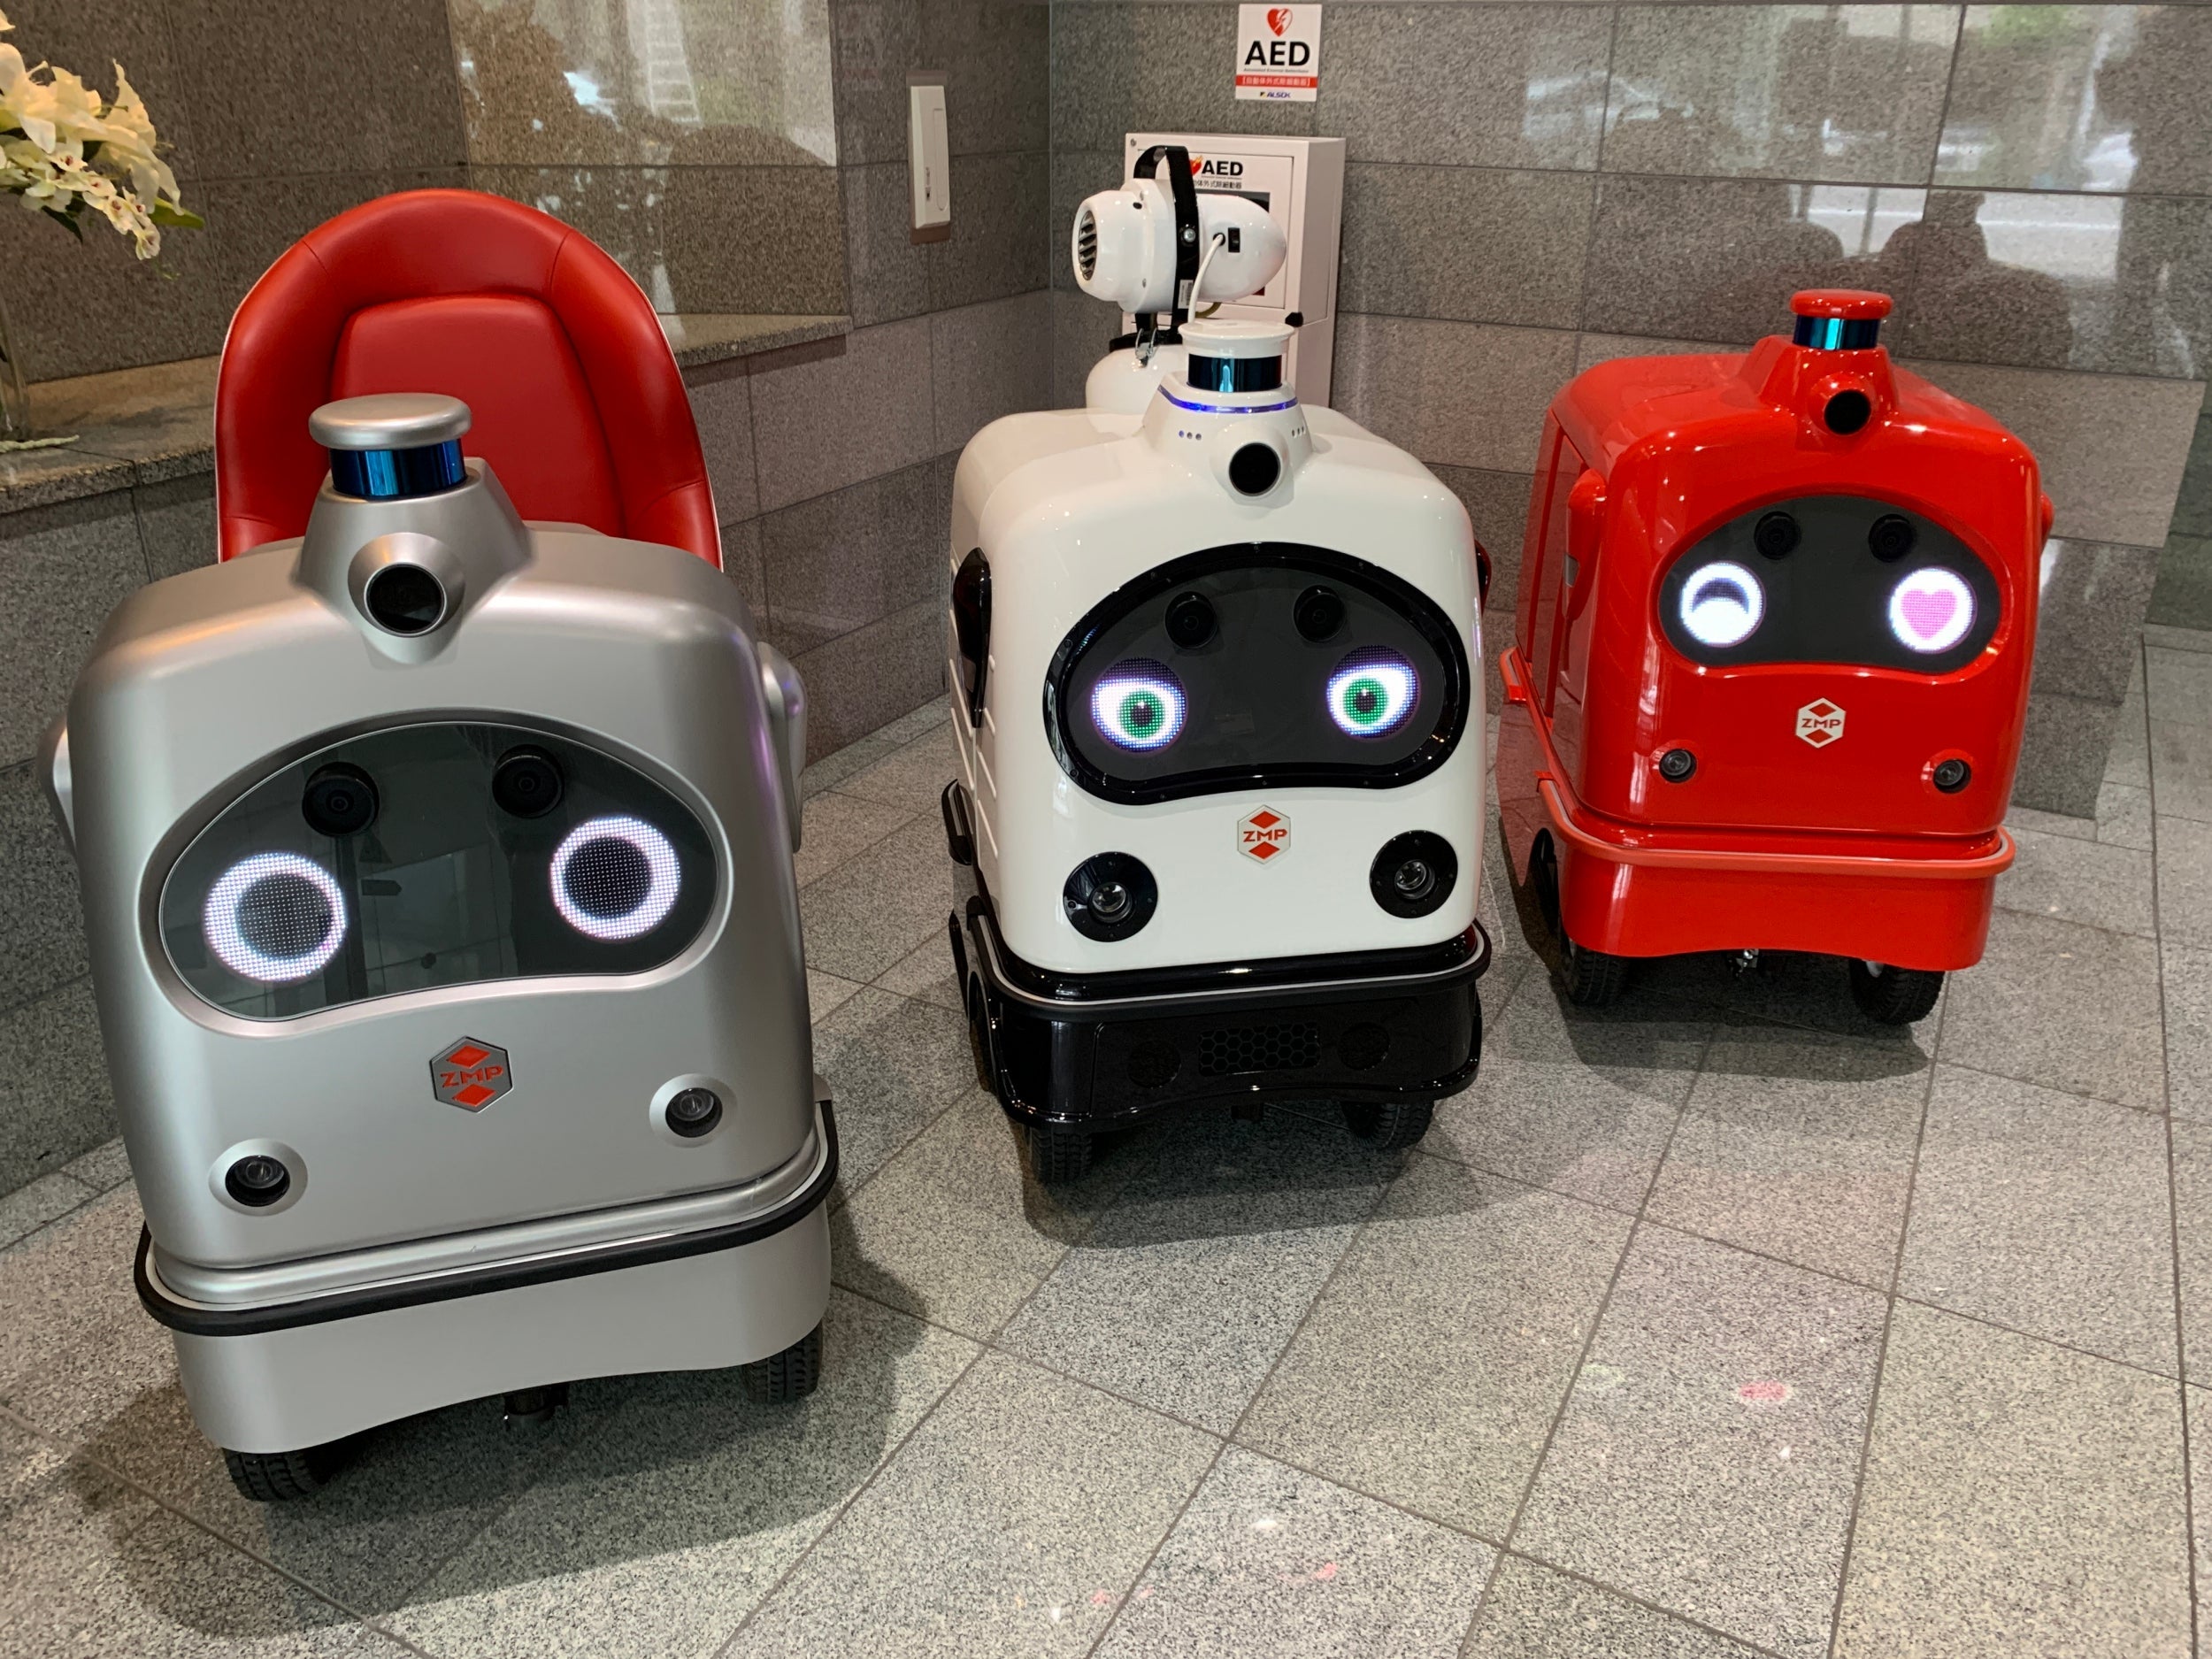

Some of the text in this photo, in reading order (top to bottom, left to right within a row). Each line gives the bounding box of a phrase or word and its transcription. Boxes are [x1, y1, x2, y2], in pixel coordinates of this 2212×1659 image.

[1244, 41, 1310, 66] AED
[1202, 160, 1244, 176] AED
[1801, 718, 1842, 729] ZMP
[1243, 828, 1288, 842] ZMP
[440, 1064, 503, 1088] ZMP
